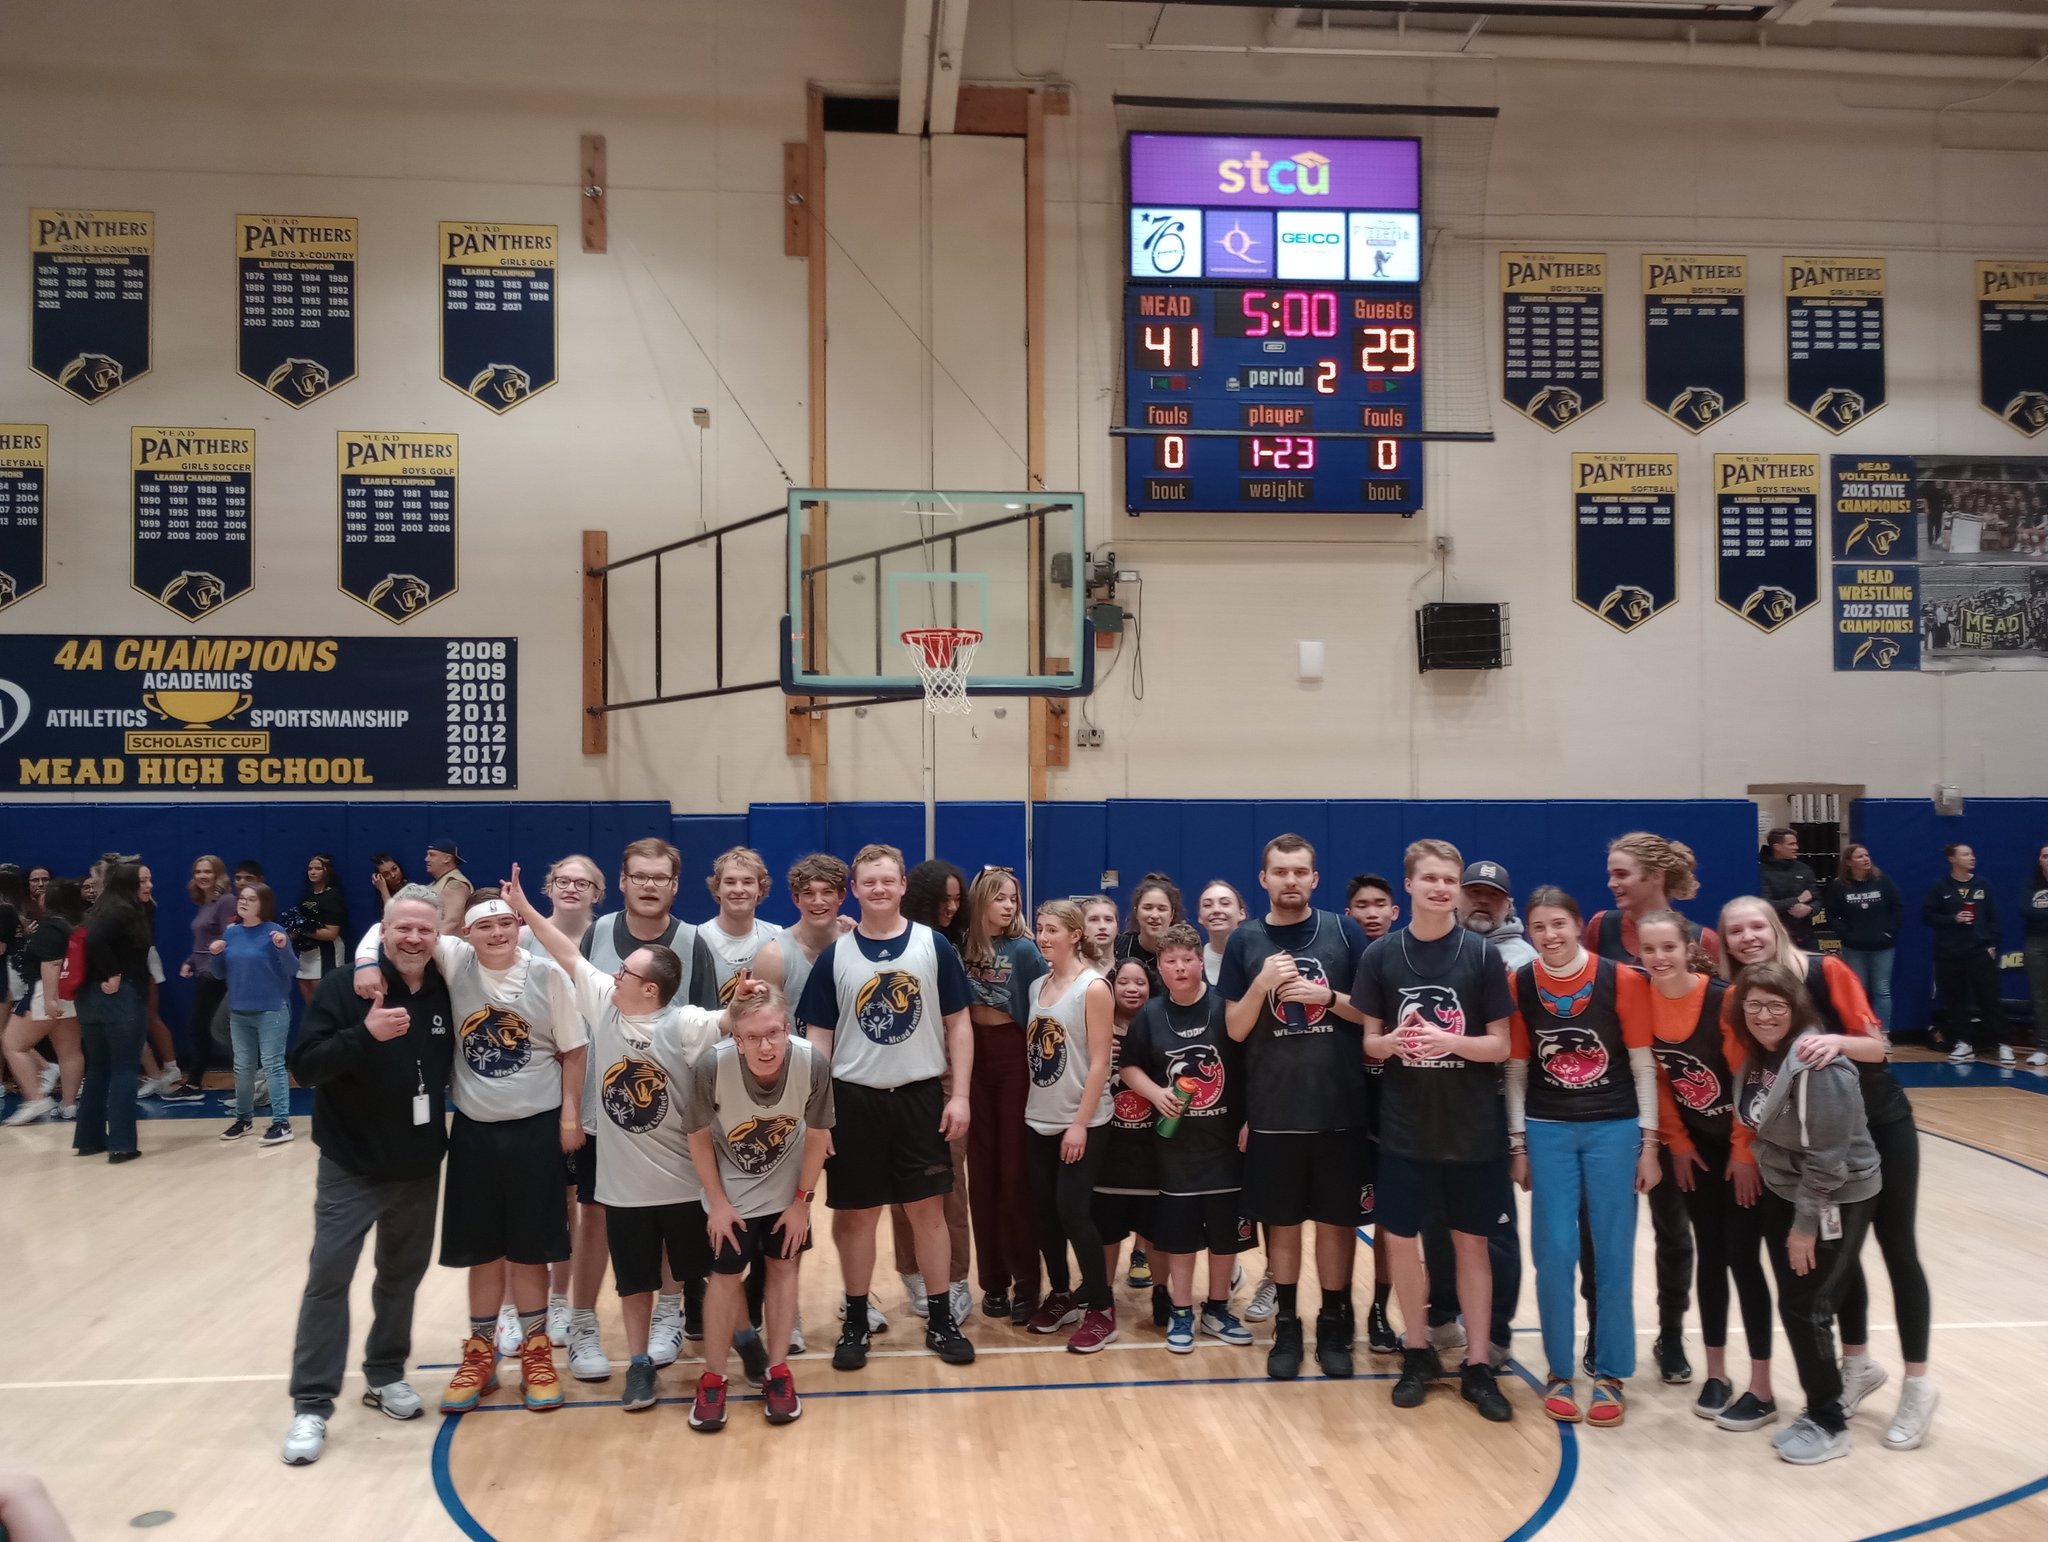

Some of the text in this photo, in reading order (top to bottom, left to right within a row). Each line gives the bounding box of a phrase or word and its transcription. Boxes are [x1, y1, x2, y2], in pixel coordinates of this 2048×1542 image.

[1218, 150, 1332, 196] stcu
[38, 219, 148, 246] PANTHERS
[244, 225, 352, 252] PANTHERS
[1282, 232, 1340, 245] GEICO
[62, 244, 148, 254] GIRLS X-COUNTRY
[448, 232, 552, 259] PANTHERS
[271, 250, 354, 260] BOYS X-COUNTRY
[500, 258, 527, 266] GIRLS
[1507, 262, 1600, 288] PANTHERS
[1648, 264, 1742, 289] PANTHERS
[1790, 267, 1881, 291] PANTHERS
[1140, 296, 1191, 316] MEAD
[1242, 292, 1337, 338] 5:00
[1355, 300, 1413, 320] Guests
[1144, 327, 1200, 368] 41
[1362, 328, 1415, 373] 29
[1248, 367, 1304, 390] period
[1316, 361, 1337, 394] 2
[1148, 404, 1188, 426] fouls
[1248, 406, 1304, 427] player
[1364, 407, 1403, 428] fouls
[0, 435, 42, 449] HERS
[362, 434, 400, 442] MEAD
[139, 437, 249, 465] PANTHERS
[346, 442, 452, 469] PANTHERS
[1164, 436, 1184, 469] 0
[1377, 439, 1397, 470] 0
[402, 467, 426, 475] BOYS
[1579, 463, 1672, 488] PANTHERS
[1722, 464, 1814, 489] PANTHERS
[1839, 473, 1910, 481] VOLLEYBALL
[140, 484, 245, 495] 1986 1987 1988 1989
[347, 488, 449, 499] 1977 1980 1981 1982
[1151, 482, 1186, 500] bout
[1249, 480, 1304, 502] weight
[1368, 484, 1402, 502] bout
[1842, 484, 1905, 498] 2021 STATE
[140, 496, 245, 507] 1990 1991 1992 1993
[347, 499, 449, 510] 1985 1987 1988 1989
[1837, 500, 1911, 513] CHAMPIONS!
[140, 507, 245, 518] 1994 1995 1996 1997
[347, 511, 449, 522] 1990 1991 1992 1993
[140, 519, 246, 530] 1999 2001 2002 2006
[347, 522, 450, 533] 1995 2001 2003 2006
[139, 530, 245, 541] 2007 2008 2009 2016
[346, 534, 395, 543] 2007 2022
[1857, 570, 1894, 584] MEAD
[1839, 586, 1913, 601] WRESTLING
[1843, 604, 1909, 617] 2022 STATE
[1840, 620, 1914, 634] CHAMPIONS!
[1966, 612, 2020, 633] MEAD
[54, 640, 339, 673] 4A CHAMPIONS
[447, 642, 505, 659] 2008
[446, 663, 505, 680] 2009
[143, 672, 253, 690] ACADEMICS
[447, 683, 505, 701] 2010
[46, 709, 148, 728] ATHLETICS
[250, 710, 409, 729] SPORTSMANSHIP
[447, 704, 506, 721] 2011
[447, 725, 505, 742] 2012
[132, 736, 262, 750] SCHOLASTIC CUP
[448, 745, 506, 763] 2017
[20, 758, 374, 785] MEAD HIGH SCHOOL
[448, 766, 506, 784] 2019
[888, 1000, 922, 1044] Mead Unified
[1040, 1048, 1066, 1087] Mead Unified
[632, 1096, 668, 1134] Mead Unified
